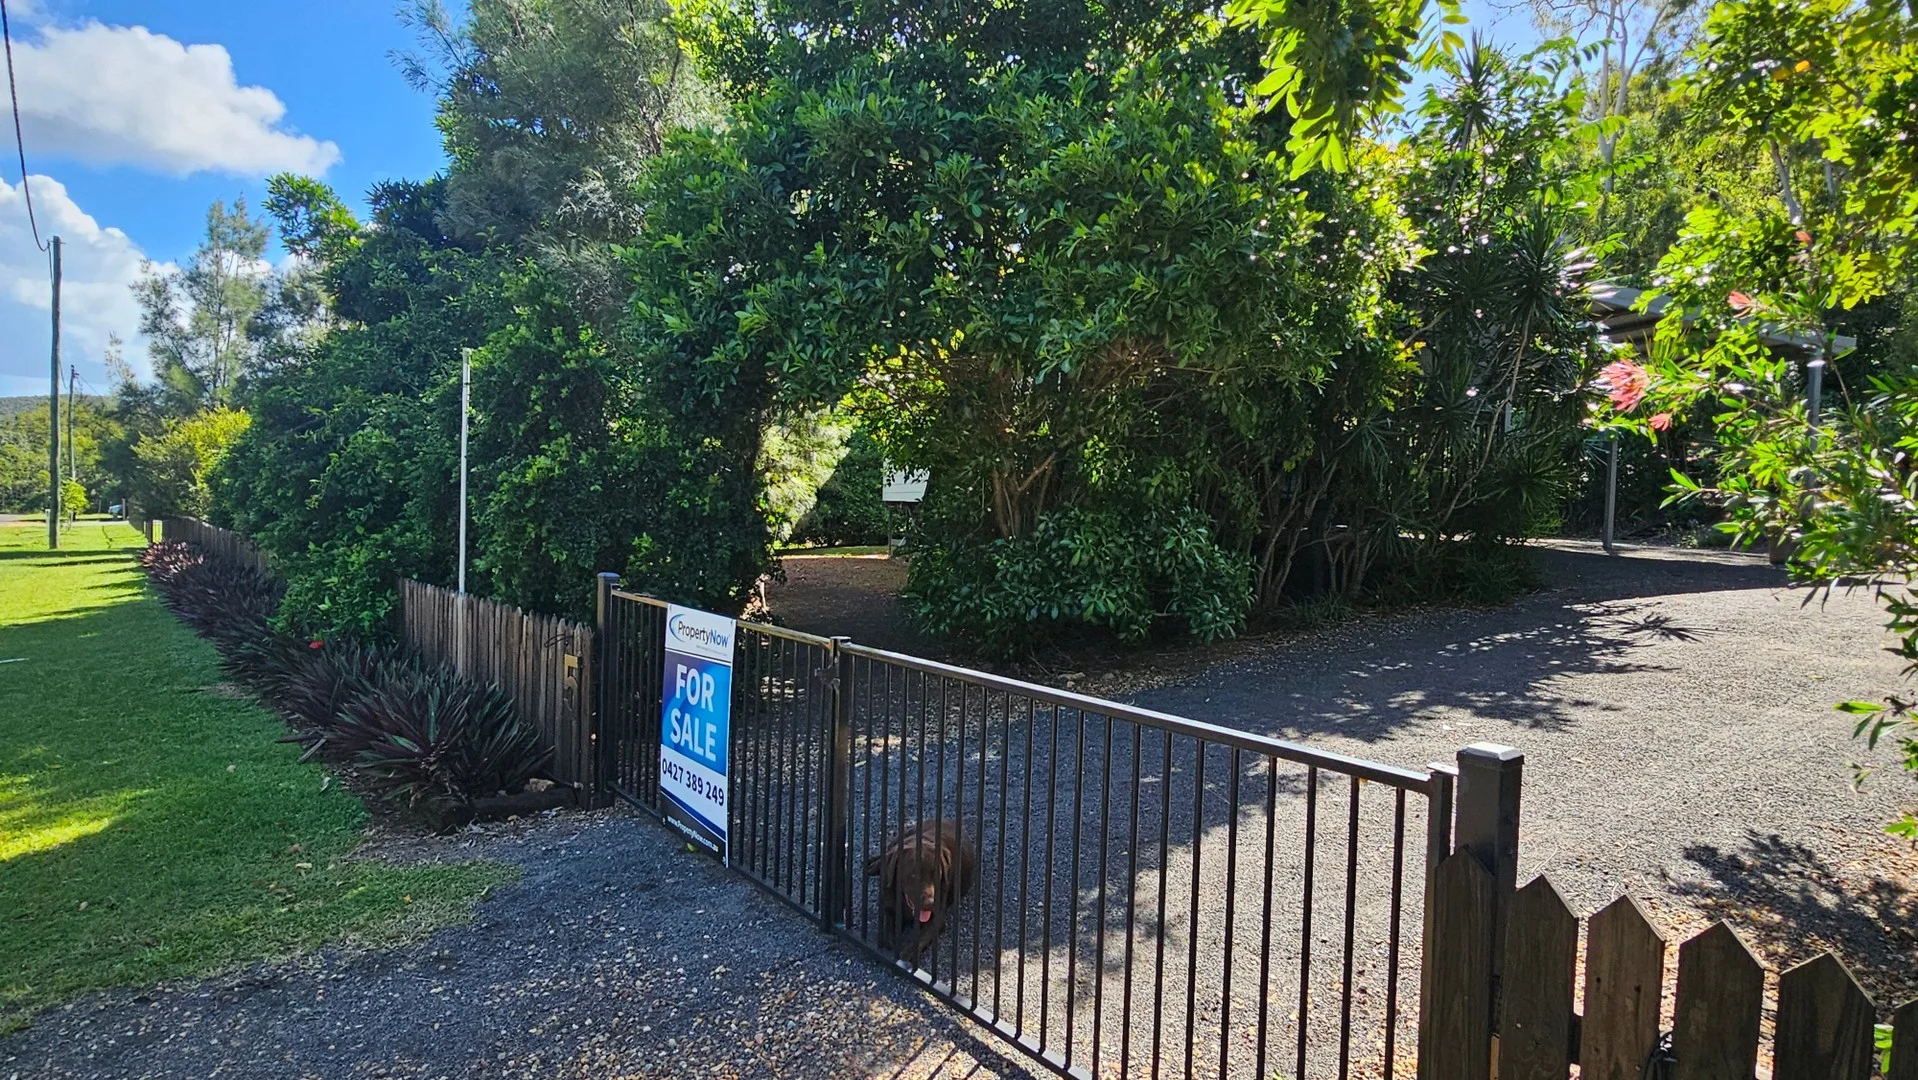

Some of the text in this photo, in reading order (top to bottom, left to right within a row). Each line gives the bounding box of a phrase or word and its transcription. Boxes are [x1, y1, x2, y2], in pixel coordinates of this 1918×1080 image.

[678, 621, 728, 648] PropertyNow
[564, 654, 578, 711] 5
[676, 664, 714, 712] FOR
[670, 709, 716, 762] SALE
[662, 758, 724, 806] 0427 389 249
